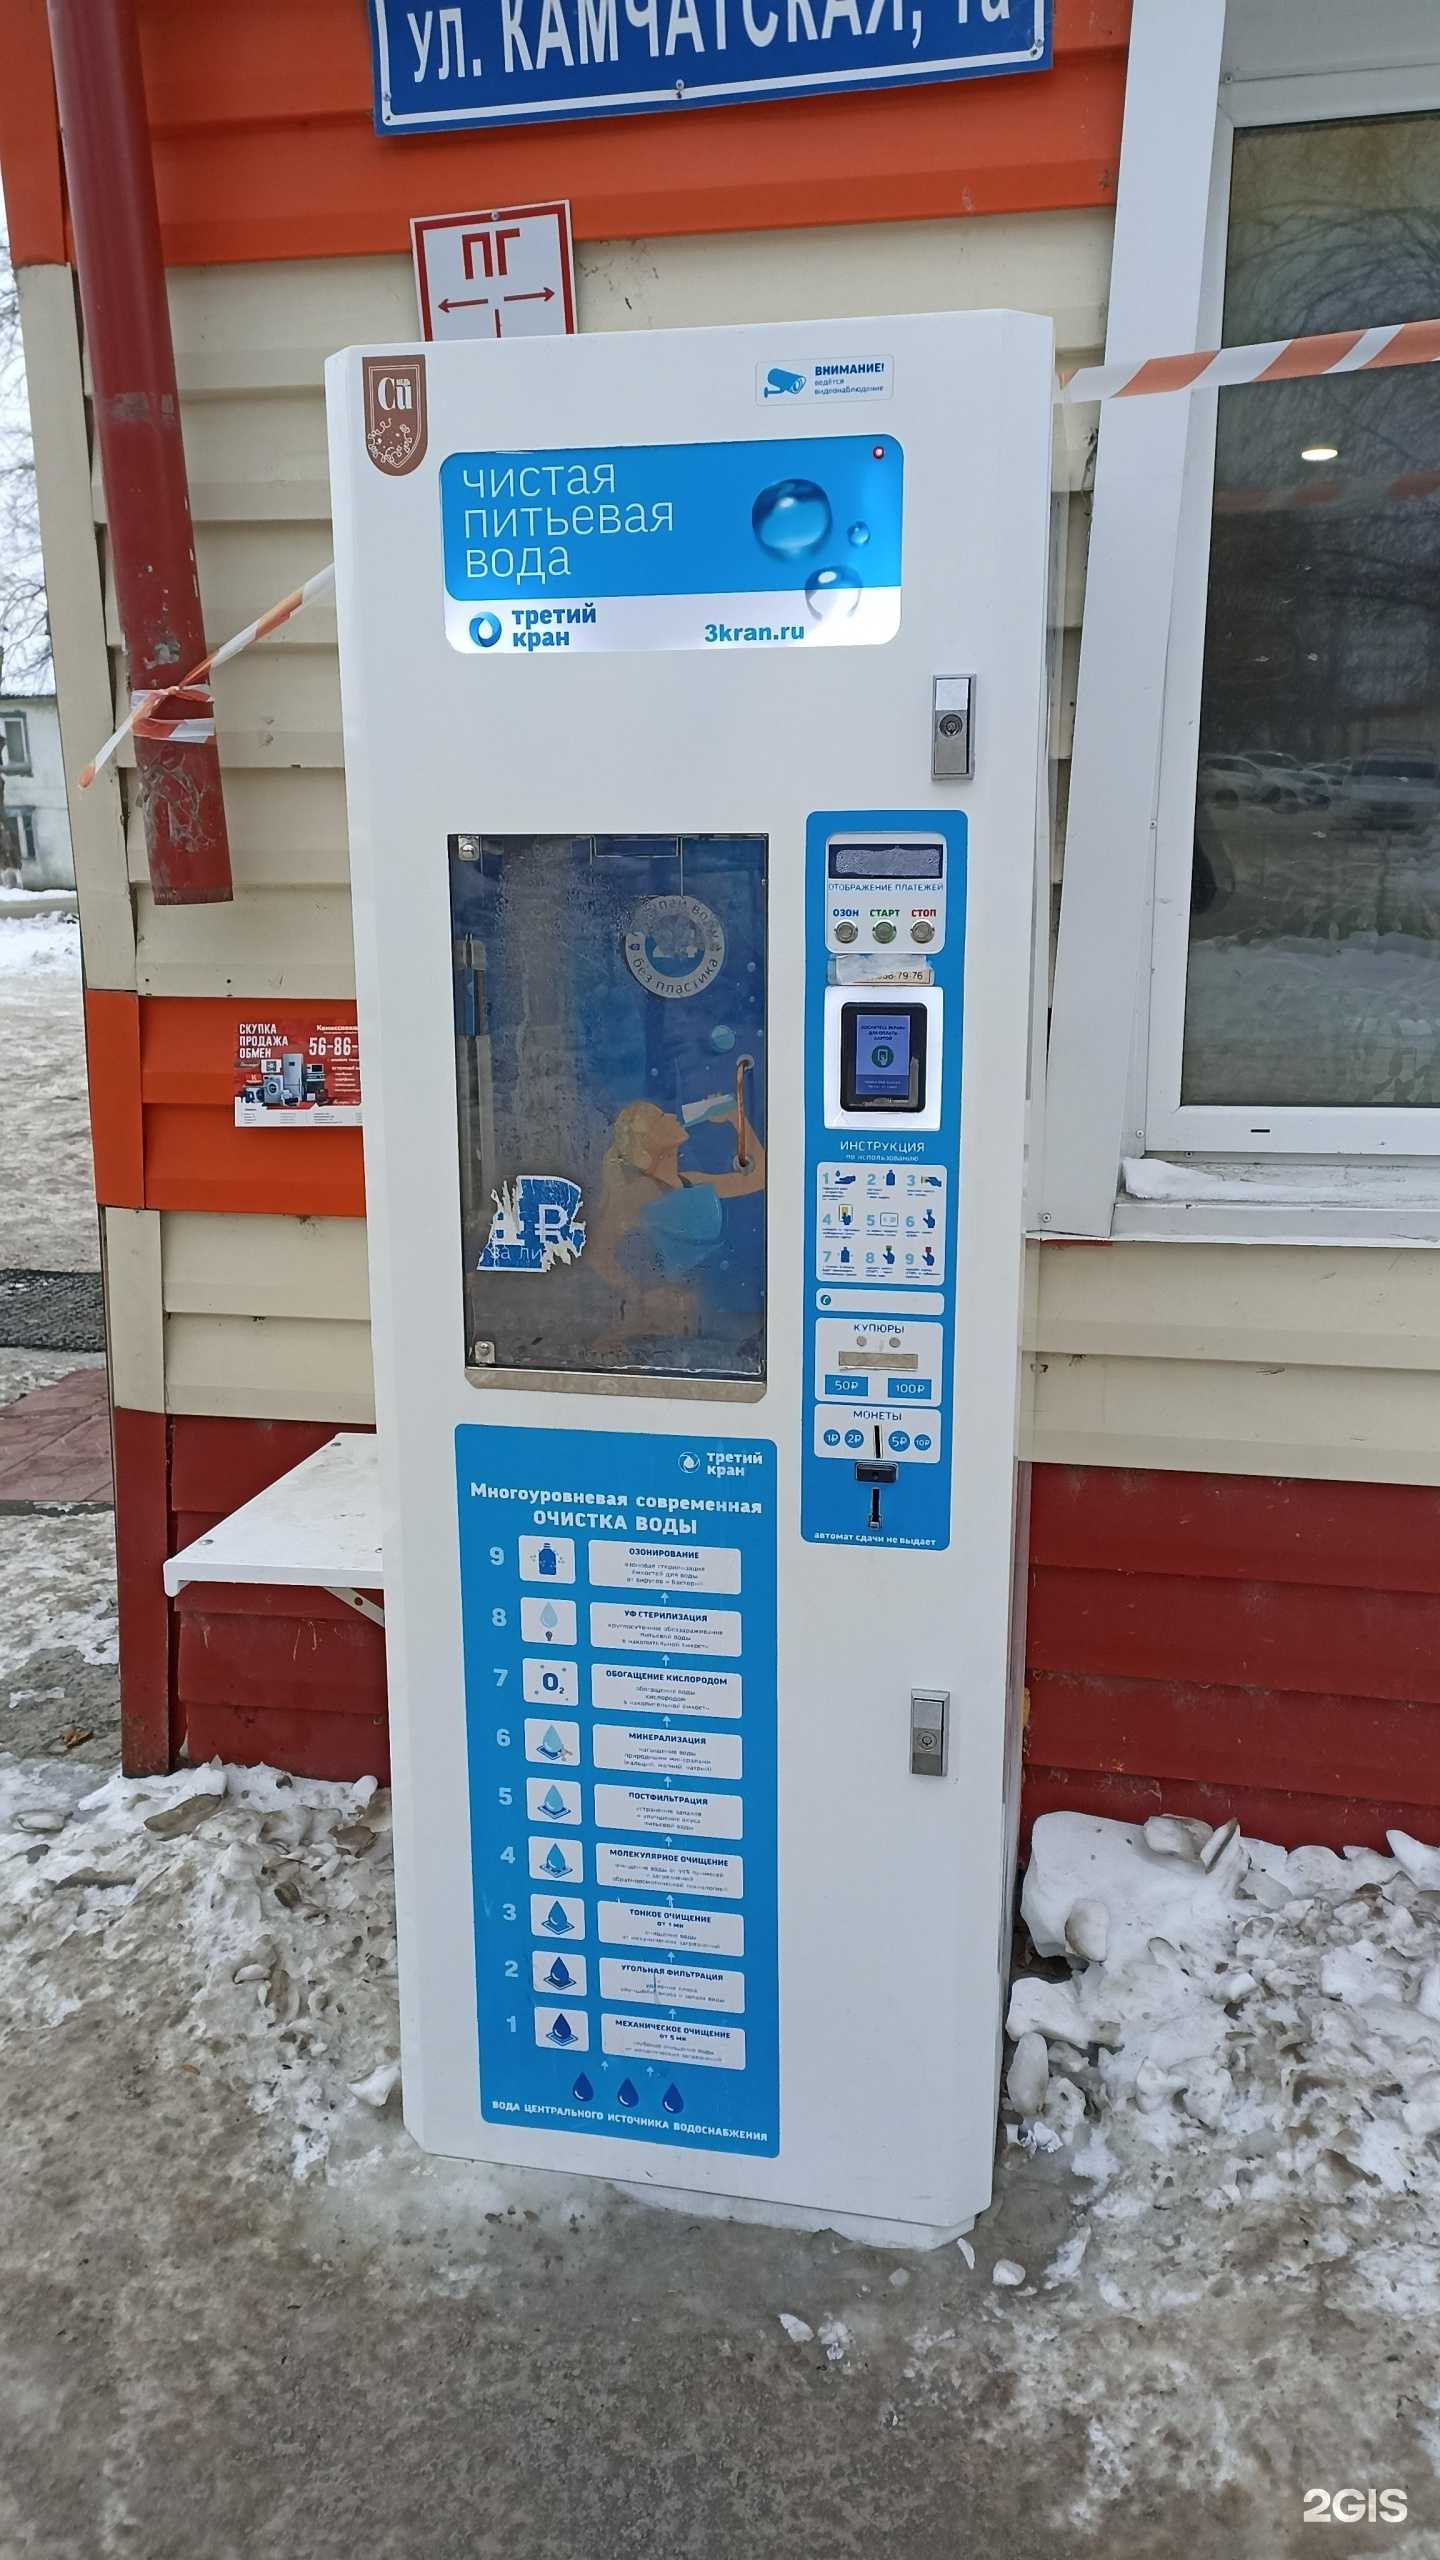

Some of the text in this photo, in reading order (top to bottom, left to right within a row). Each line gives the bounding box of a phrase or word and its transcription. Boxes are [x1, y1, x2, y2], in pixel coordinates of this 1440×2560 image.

[407, 8, 481, 82] ул.
[462, 228, 520, 280] ПГ
[815, 362, 884, 376] ВНИМАНИЕ!
[463, 464, 615, 498] чистая
[464, 502, 673, 538] питьевая
[466, 546, 571, 585] вода
[512, 602, 597, 629] третий
[704, 624, 805, 642] 3kran.ru
[513, 631, 570, 651] кран
[828, 883, 944, 892] ОТОБРАЖЕНИЕ ПЛАТЕЖЕЙ
[833, 908, 859, 917] ОЗОН
[869, 908, 900, 917] СТАРТ
[911, 908, 937, 917] СТОП
[633, 958, 653, 982] без
[656, 958, 718, 993] пластика
[240, 1023, 277, 1034] СКУПКА
[240, 1036, 288, 1047] ПРОДАЖА
[240, 1048, 272, 1059] ОБМЕН
[840, 1140, 925, 1152] ИНСТРУКЦИЯ
[823, 1172, 829, 1184] 1
[867, 1174, 876, 1185] 2
[906, 1175, 916, 1186] 3
[822, 1214, 831, 1225] 4
[867, 1215, 875, 1226] 5
[906, 1216, 914, 1227] 6
[823, 1251, 831, 1262] 7
[865, 1252, 874, 1263] 8
[905, 1253, 914, 1264] 9
[854, 1324, 904, 1333] КУПЮРЫ
[853, 1410, 902, 1421] МОНЕТЫ
[706, 1451, 763, 1465] третий
[706, 1464, 745, 1477] кран
[470, 1482, 762, 1514] Многоуровневая современная
[533, 1510, 697, 1535] ОЧИСТКА ВОДЫ
[814, 1532, 854, 1540] автомат
[855, 1534, 884, 1542] сдачи
[899, 1538, 937, 1546] выдает
[489, 1546, 505, 1566] 9
[629, 1548, 700, 1559] ОЗОНИРОВАНИЕ
[491, 1607, 507, 1627] 8
[638, 1611, 708, 1622] СТЕРИЛИЗАЦИЯ
[493, 1668, 508, 1687] 7
[606, 1670, 728, 1685] ОБОГАЩЕНИЕ КИСЛОРОДОМ
[496, 1728, 511, 1747] 6
[629, 1733, 706, 1744] МИНЕРАЛИЗАЦИЯ
[498, 1787, 513, 1806] 5
[628, 1792, 708, 1805] ПОСТФИЛЬТРАЦИЯ
[500, 1846, 515, 1864] 4
[609, 1849, 729, 1867] МОЛЕКУЛЯРНОЕ ОЧИЩЕНИЕ
[503, 1903, 517, 1920] 3
[630, 1909, 711, 1923] ТОНКОЕ ОЧИЩЕНИЕ
[505, 1960, 519, 1978] 2
[621, 1964, 724, 1981] УГОЛЬНАЯ ФИЛЬТРАЦИЯ
[506, 2015, 517, 2032] 1
[615, 2019, 731, 2039] МЕХАНИЧЕСКОЕ ОЧИЩЕНИЕ
[492, 2101, 768, 2141] ВОДА ЦЕНТРАЛЬНОГО ИСТОЧНИКА ВОДОСНАБЖЕНИЯ
